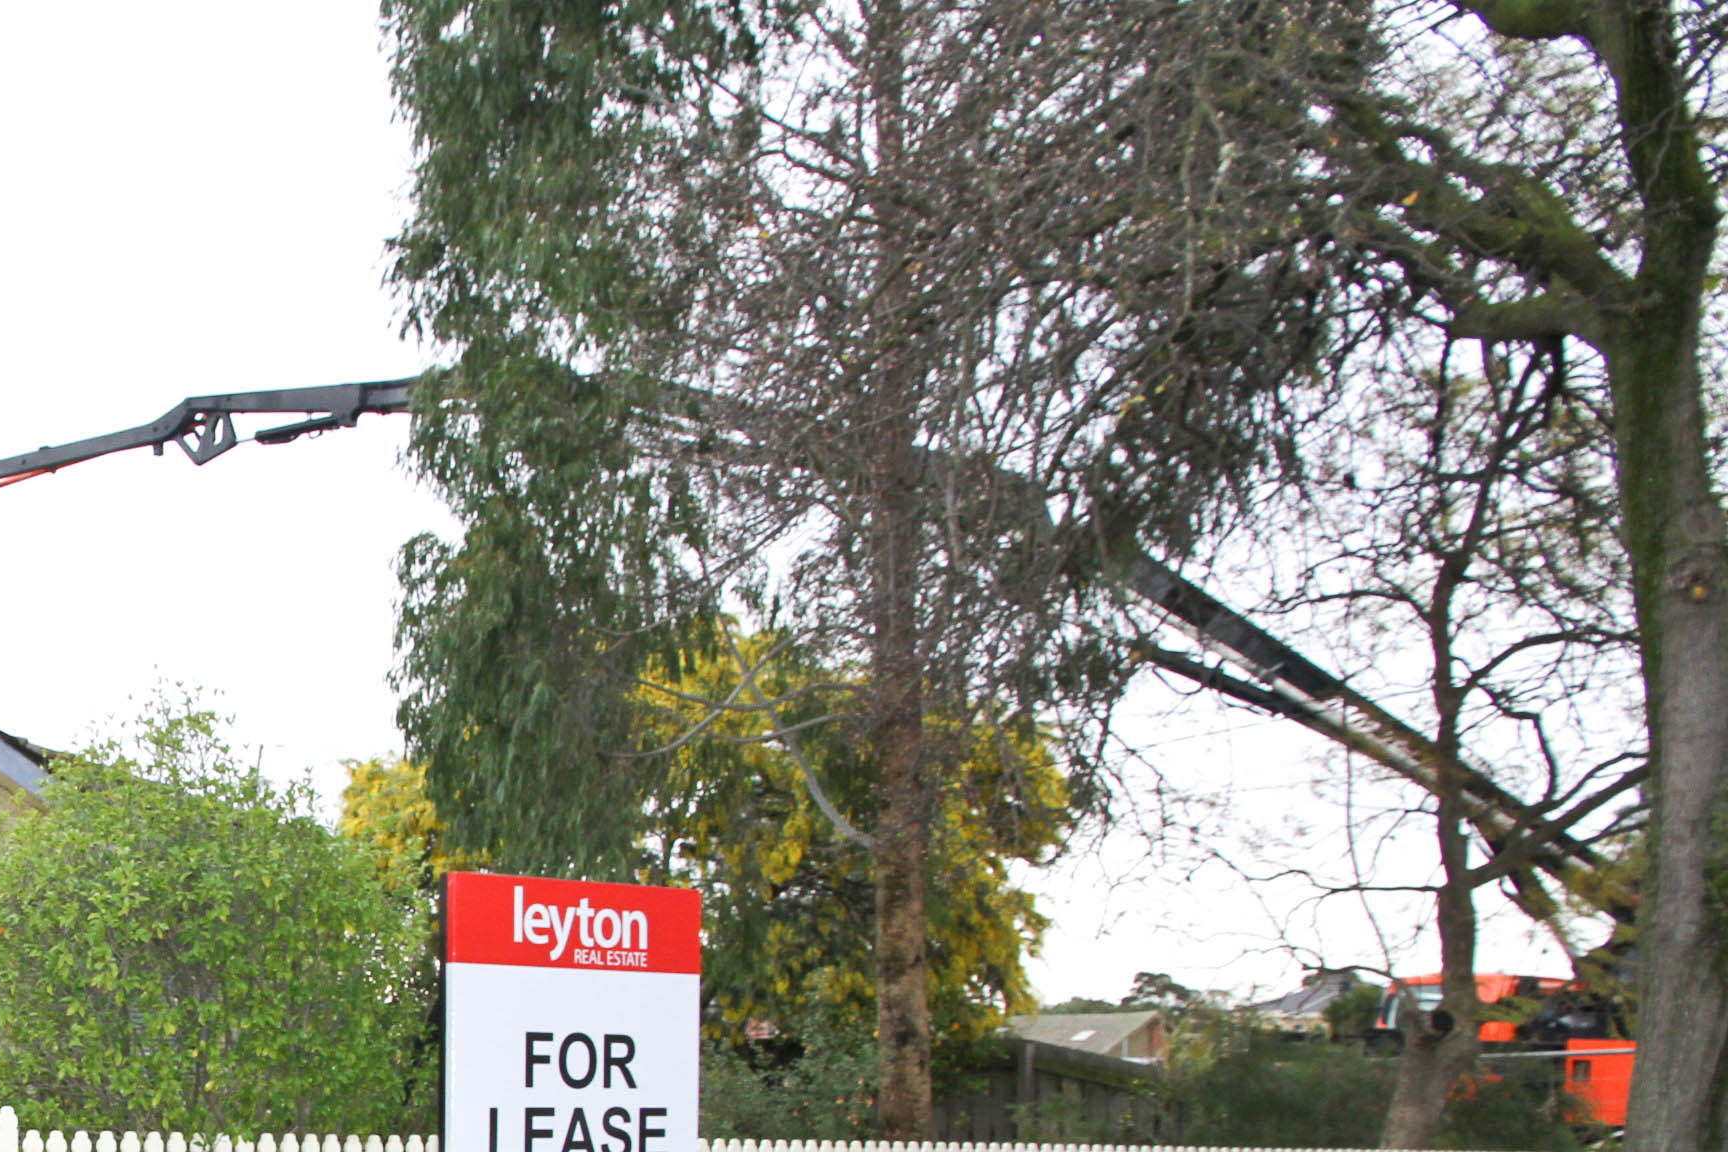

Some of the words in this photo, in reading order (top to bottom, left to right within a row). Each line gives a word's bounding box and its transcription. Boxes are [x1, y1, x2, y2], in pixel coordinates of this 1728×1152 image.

[513, 886, 649, 961] leyton
[574, 948, 605, 966] REAL
[606, 950, 648, 968] ESTATE
[524, 1031, 638, 1090] FOR
